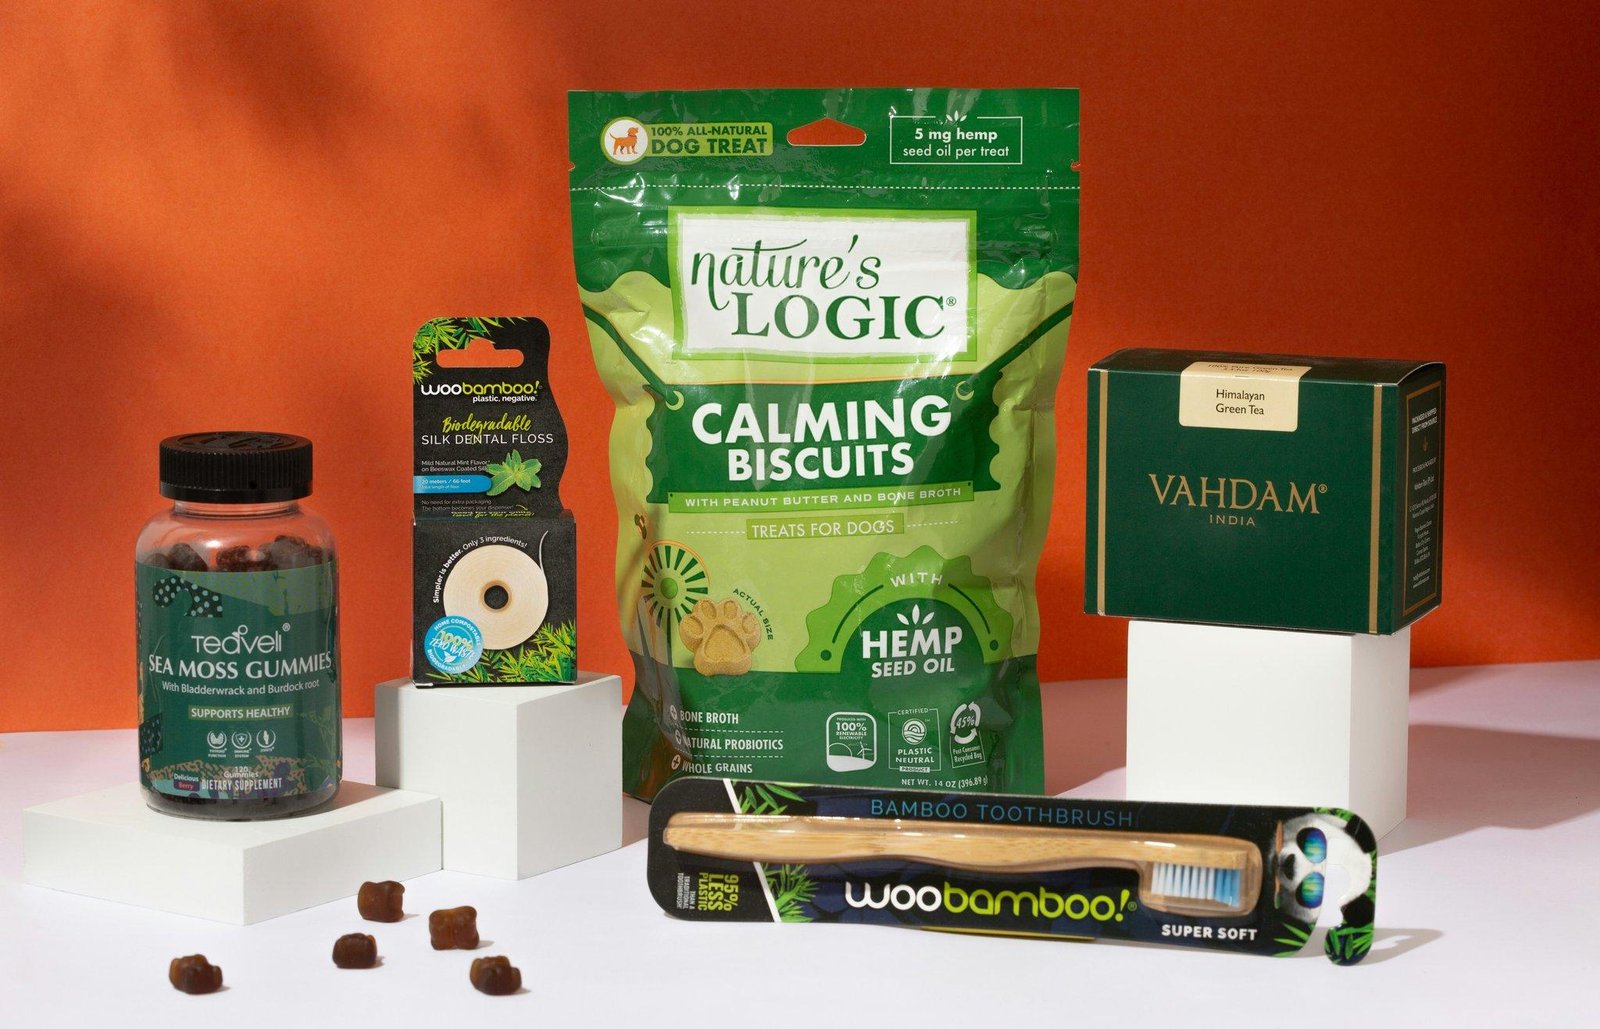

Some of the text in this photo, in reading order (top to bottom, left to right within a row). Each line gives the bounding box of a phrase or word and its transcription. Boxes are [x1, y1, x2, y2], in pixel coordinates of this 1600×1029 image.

[651, 125, 767, 136] 100% ALL-NATURAL
[915, 128, 998, 143] 5 mg hemp
[652, 138, 767, 154] DOG TREAT
[903, 144, 1009, 159] seed oil per treat
[691, 234, 881, 311] nature's
[1216, 388, 1265, 402] Himalayan
[1216, 404, 1264, 415] Green Tea
[442, 412, 532, 436] Biodegradable
[692, 395, 952, 446] CALMING
[422, 433, 554, 445] SILK DENTAL FLOSS
[728, 442, 914, 482] BISCUITS
[685, 488, 962, 508] WITH PEANUT BUTTER AND BONE BROTH
[1210, 514, 1255, 526] INDIA
[752, 520, 894, 538] TREATS FOR DOGS
[432, 574, 444, 604] Simpler
[439, 567, 447, 575] is
[443, 549, 464, 568] better.
[462, 539, 479, 551] Only
[485, 536, 528, 549] ingredients!
[890, 572, 944, 588] WITH
[732, 588, 774, 640] ACTUAL SIZE
[862, 626, 963, 659] HEMP
[149, 650, 332, 679] SEA MOSS GUMMIES
[872, 657, 955, 678] SEED OIL
[162, 679, 319, 696] With Bladderwrack and Burdock root
[191, 706, 290, 719] SUPPORTS HEALTHY
[680, 710, 739, 724] BONE BROTH
[898, 708, 929, 716] CERTIFIED
[836, 722, 867, 732] 100%
[956, 716, 975, 729] 45%
[682, 735, 784, 750] NATURAL PROBIOTICS
[898, 747, 932, 756] PLASTIC
[954, 752, 982, 763] Recycled Bag
[682, 761, 752, 774] WHOLE GRAINS
[174, 773, 199, 782] Delicious
[202, 777, 282, 790] DIETARY SUPPLEMENT
[945, 780, 956, 788] OZ
[958, 776, 982, 789] (396.89
[178, 782, 194, 790] Berry
[871, 799, 1133, 827] BAMBOO TOOTHBRUSH
[698, 872, 708, 910] PLASTIC
[708, 874, 724, 910] LESS
[724, 874, 739, 911] 95%
[1161, 924, 1258, 941] SUPER SOFT
